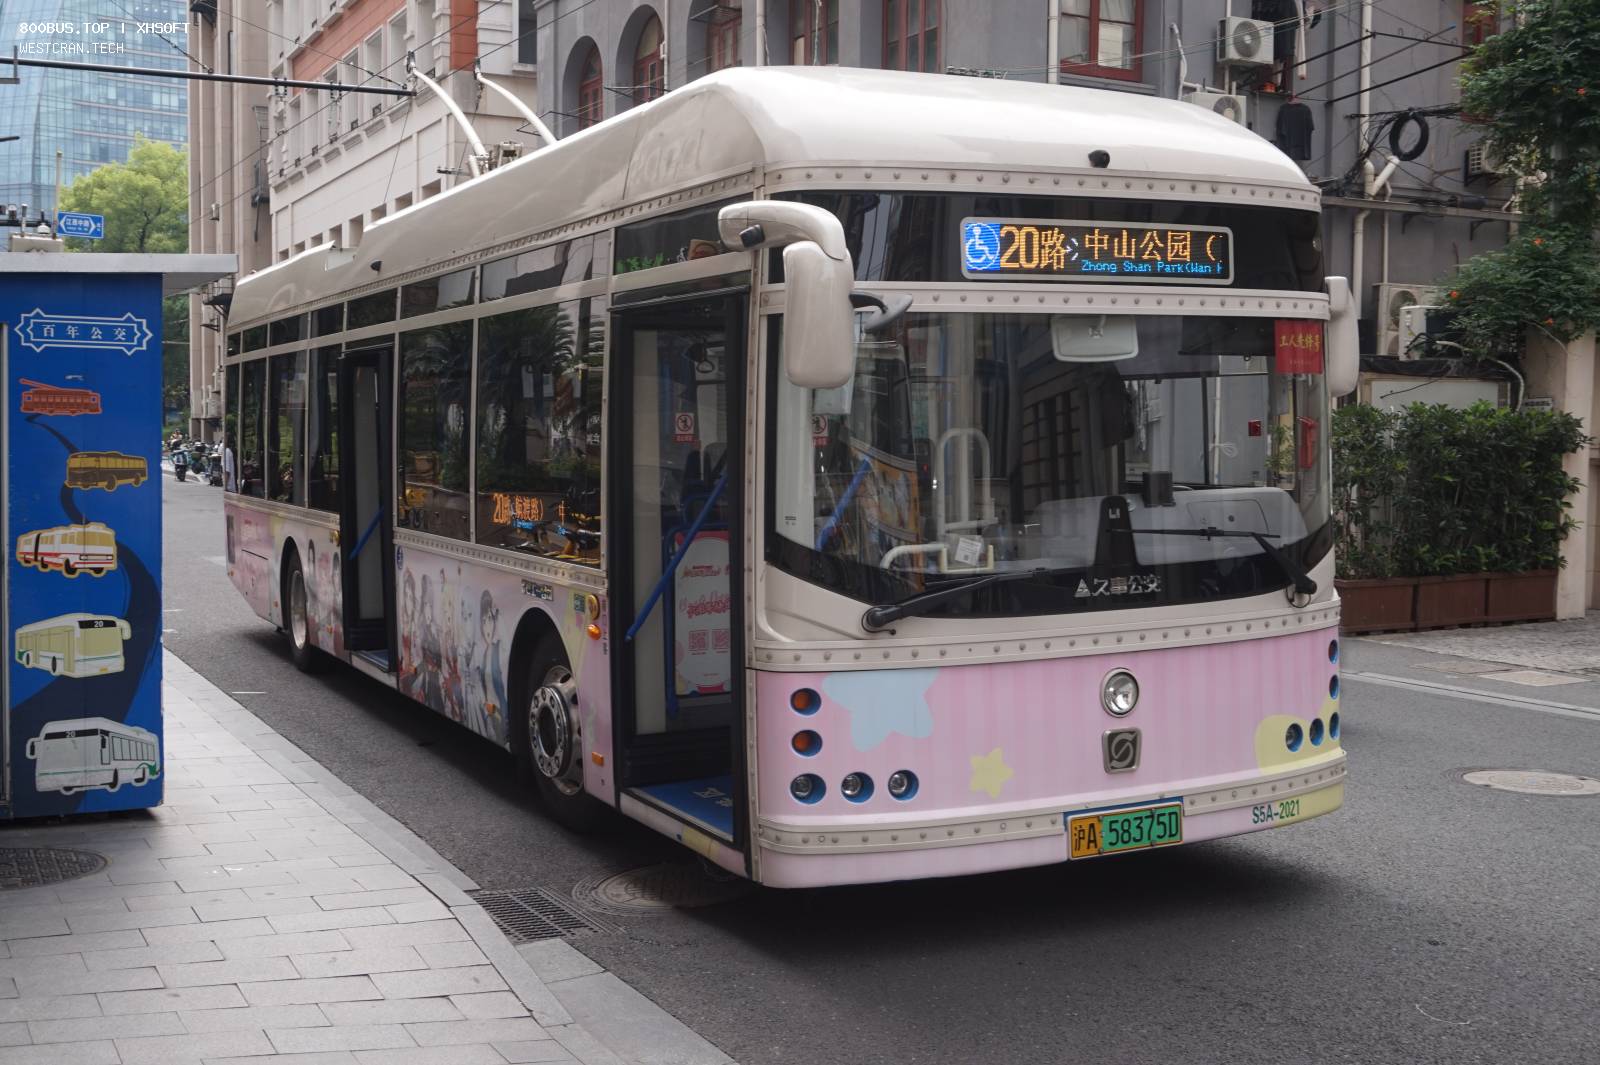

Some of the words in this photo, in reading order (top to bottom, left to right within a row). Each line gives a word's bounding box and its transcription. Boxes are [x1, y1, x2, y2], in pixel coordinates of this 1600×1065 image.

[1000, 225, 1066, 271] 20路
[1084, 228, 1191, 262] 中山公园
[1081, 260, 1117, 273] Zhong
[1123, 261, 1152, 273] Shan
[42, 324, 127, 341] 百年公交
[94, 620, 104, 628] 20
[1252, 799, 1300, 824] S5A-2021
